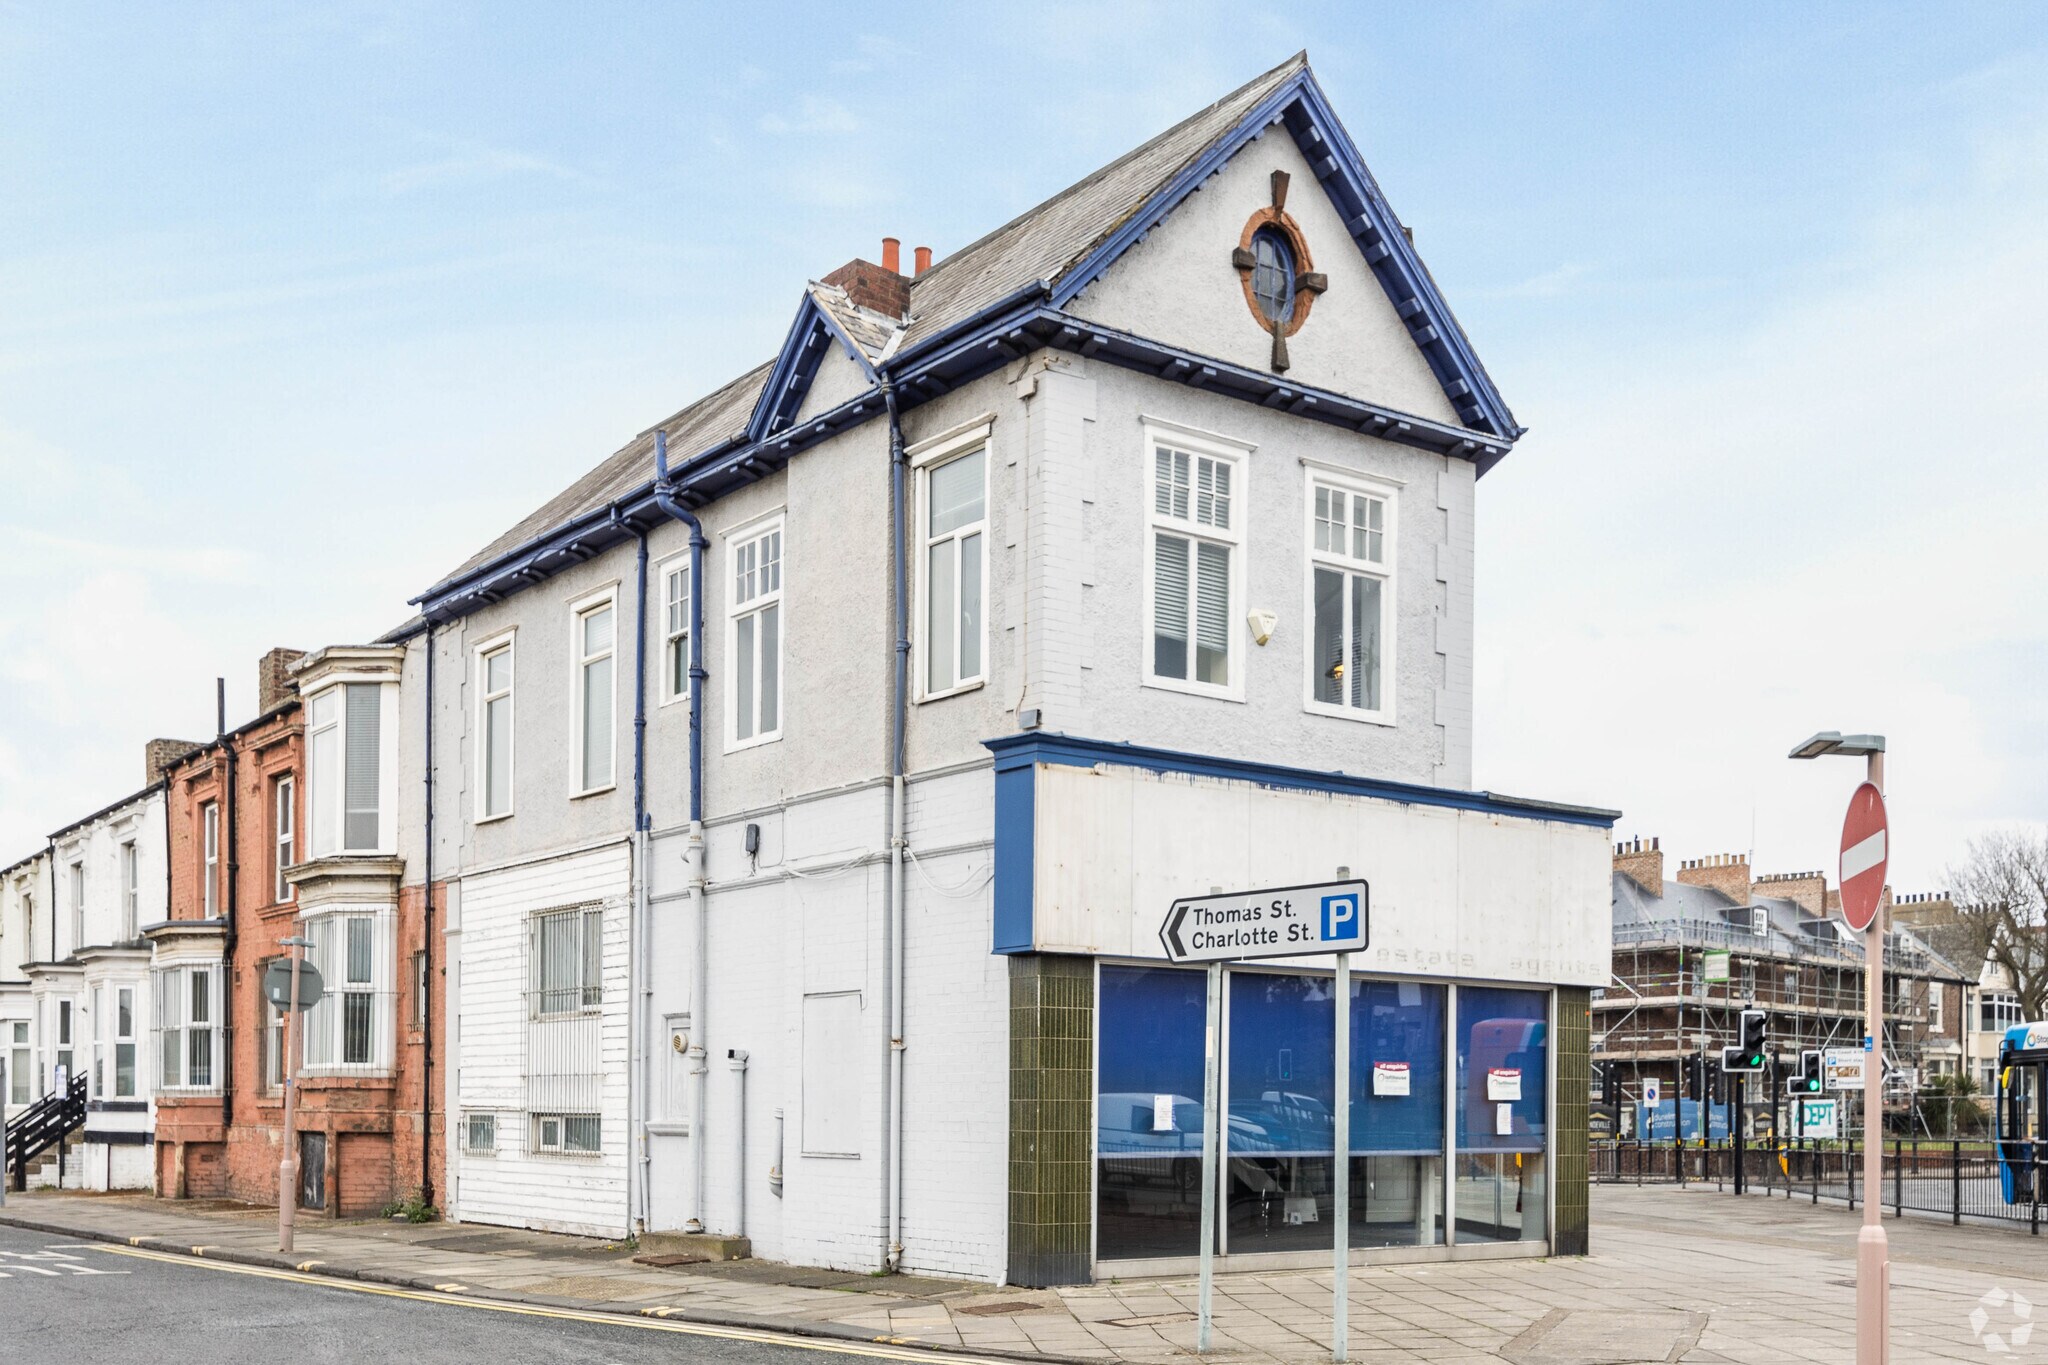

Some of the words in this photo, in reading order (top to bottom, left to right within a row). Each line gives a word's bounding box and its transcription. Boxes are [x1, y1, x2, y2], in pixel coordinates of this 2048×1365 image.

[1193, 906, 1262, 926] Thomas
[1269, 899, 1297, 919] St.
[1329, 898, 1353, 938] P
[1192, 926, 1278, 950] Charlotte
[1287, 923, 1315, 942] St.
[1376, 946, 1474, 968] estate
